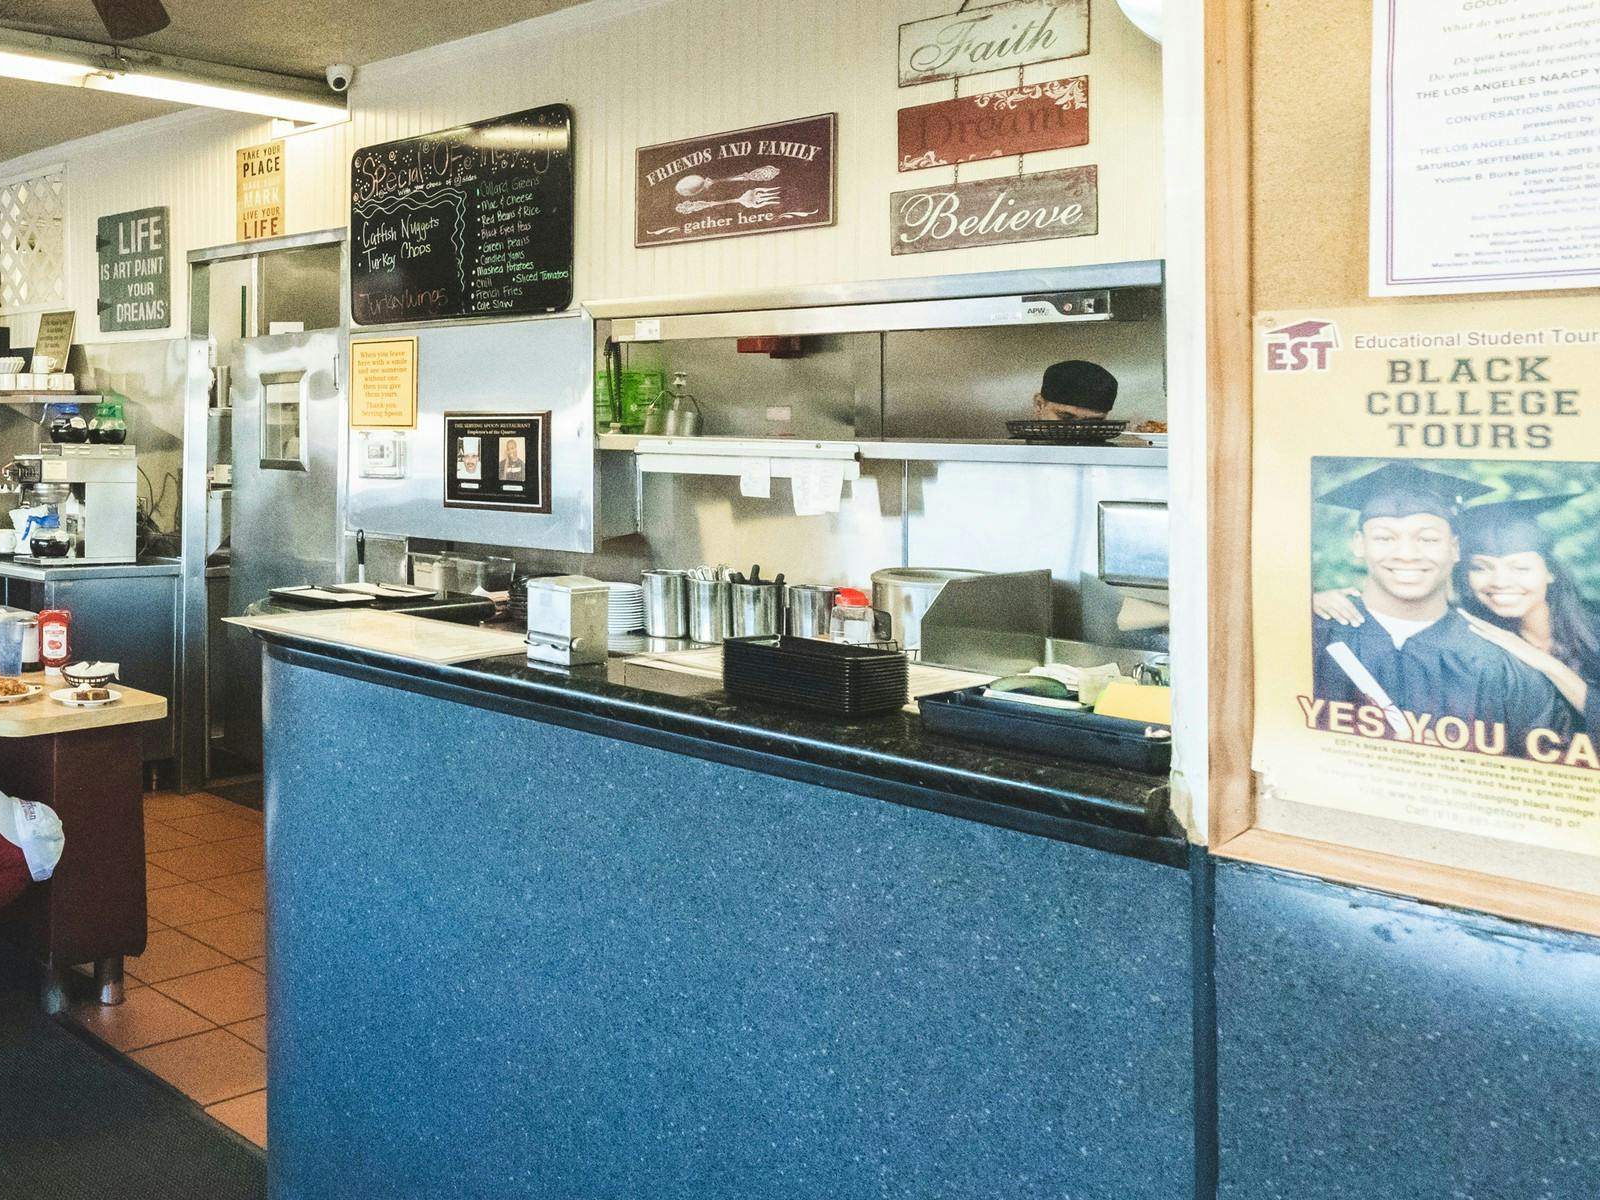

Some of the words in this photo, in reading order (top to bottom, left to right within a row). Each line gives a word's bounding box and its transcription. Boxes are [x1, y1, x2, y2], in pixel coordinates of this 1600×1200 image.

[910, 8, 1058, 72] Faith
[1416, 89, 1440, 100] THE
[1443, 84, 1469, 97] LOS
[1473, 76, 1536, 92] ANGELES
[1540, 68, 1589, 82] NAACP
[1445, 103, 1553, 125] CONVERSATIONS
[920, 106, 1065, 149] Dream
[243, 150, 259, 160] TAKE
[263, 145, 280, 156] YOUR
[646, 147, 712, 187] FRIENDS
[718, 141, 751, 159] AND
[757, 140, 822, 162] FAMILY
[243, 156, 280, 178] PLACE
[243, 210, 258, 220] LIVE
[262, 206, 280, 218] YOUR
[523, 206, 541, 217] Rice
[684, 216, 733, 233] gather
[738, 211, 774, 225] here
[901, 192, 1083, 243] Believe
[119, 216, 161, 255] LIFE
[244, 217, 278, 239] LIFE
[362, 221, 397, 248] Catfish
[401, 214, 439, 242] Nuggets
[401, 241, 431, 258] Chops
[101, 263, 110, 281] IS
[113, 261, 132, 280] ART
[134, 256, 164, 278] PAINT
[127, 281, 154, 297] YOUR
[503, 286, 522, 297] Fries
[117, 300, 165, 323] DREAMS
[1354, 333, 1460, 349] Educational
[1467, 330, 1544, 347] Student
[1267, 341, 1334, 370] EST
[1387, 356, 1551, 384] BLACK
[1366, 389, 1580, 416] COLLEGE
[1388, 423, 1553, 449] TOURS
[1297, 695, 1386, 738] YES
[1401, 709, 1505, 756] YOU
